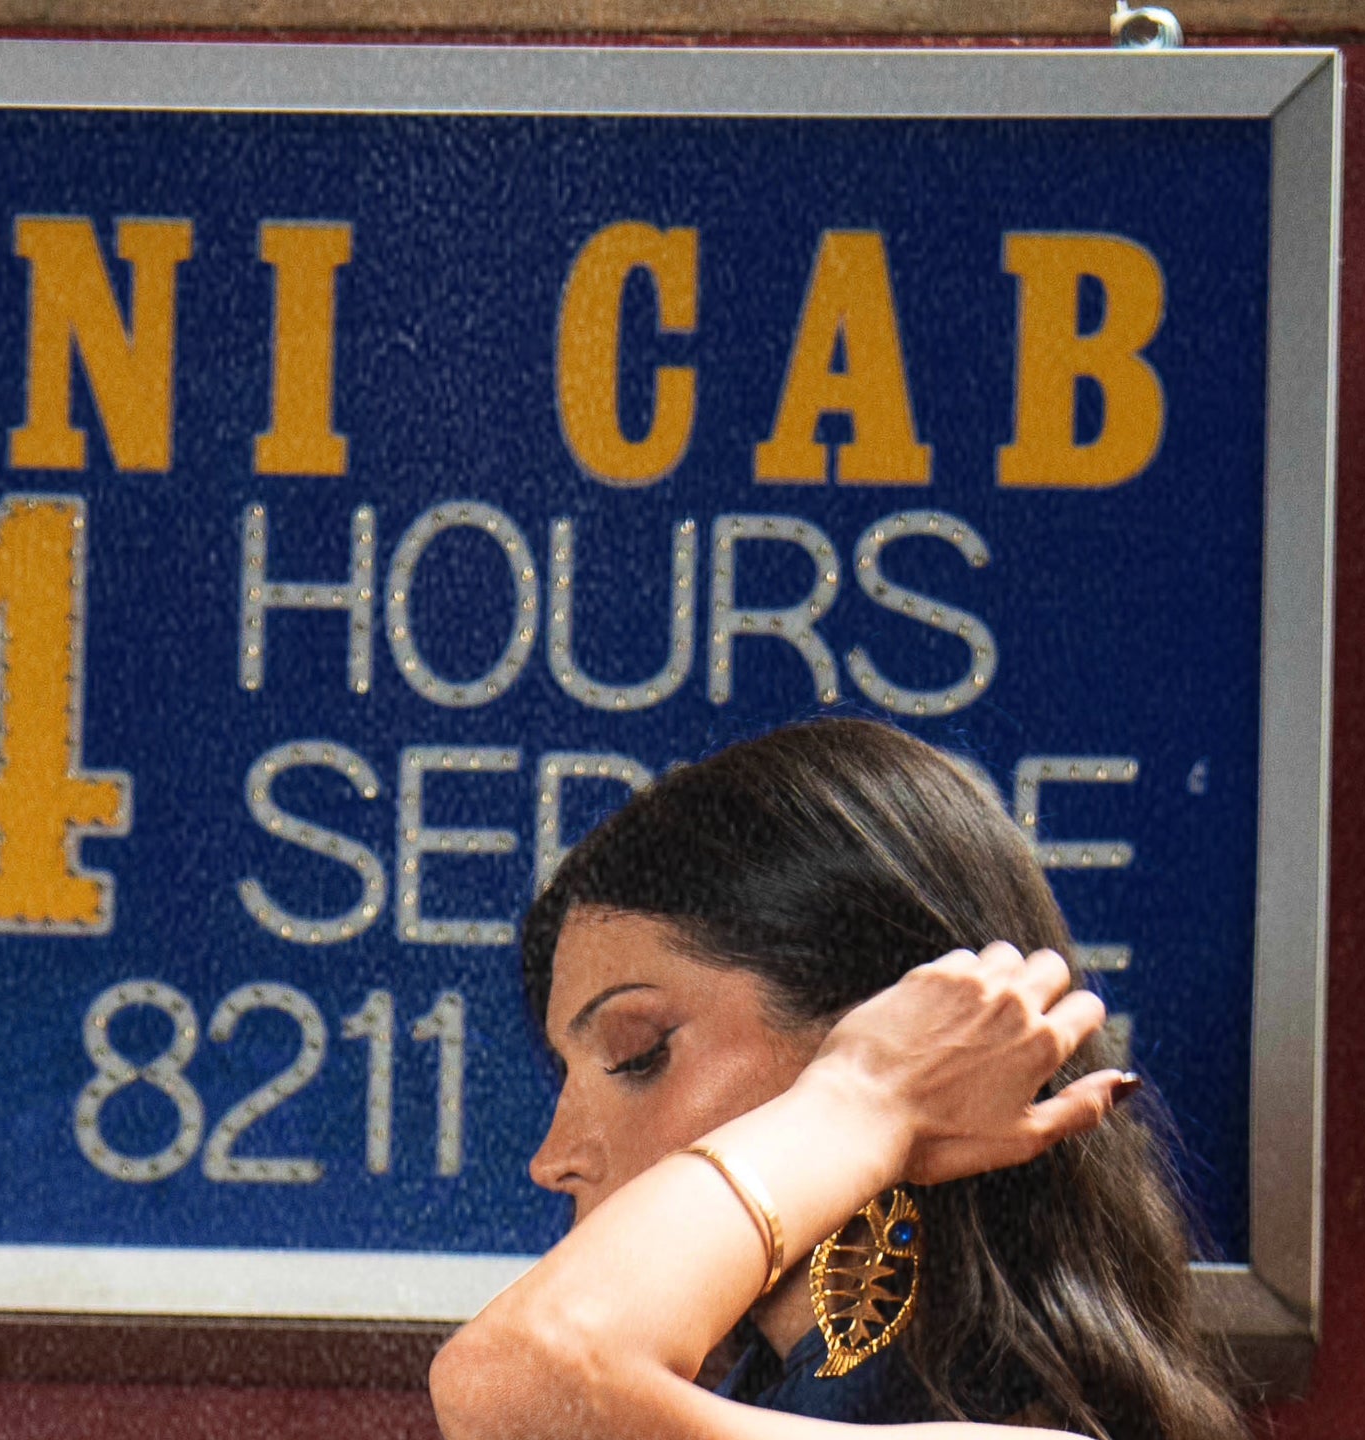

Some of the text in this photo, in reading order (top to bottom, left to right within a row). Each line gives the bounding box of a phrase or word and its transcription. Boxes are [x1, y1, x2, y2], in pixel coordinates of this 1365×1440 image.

[555, 219, 1166, 488] CAB
[240, 502, 999, 716] HOURS
[73, 981, 469, 1186] 8211
